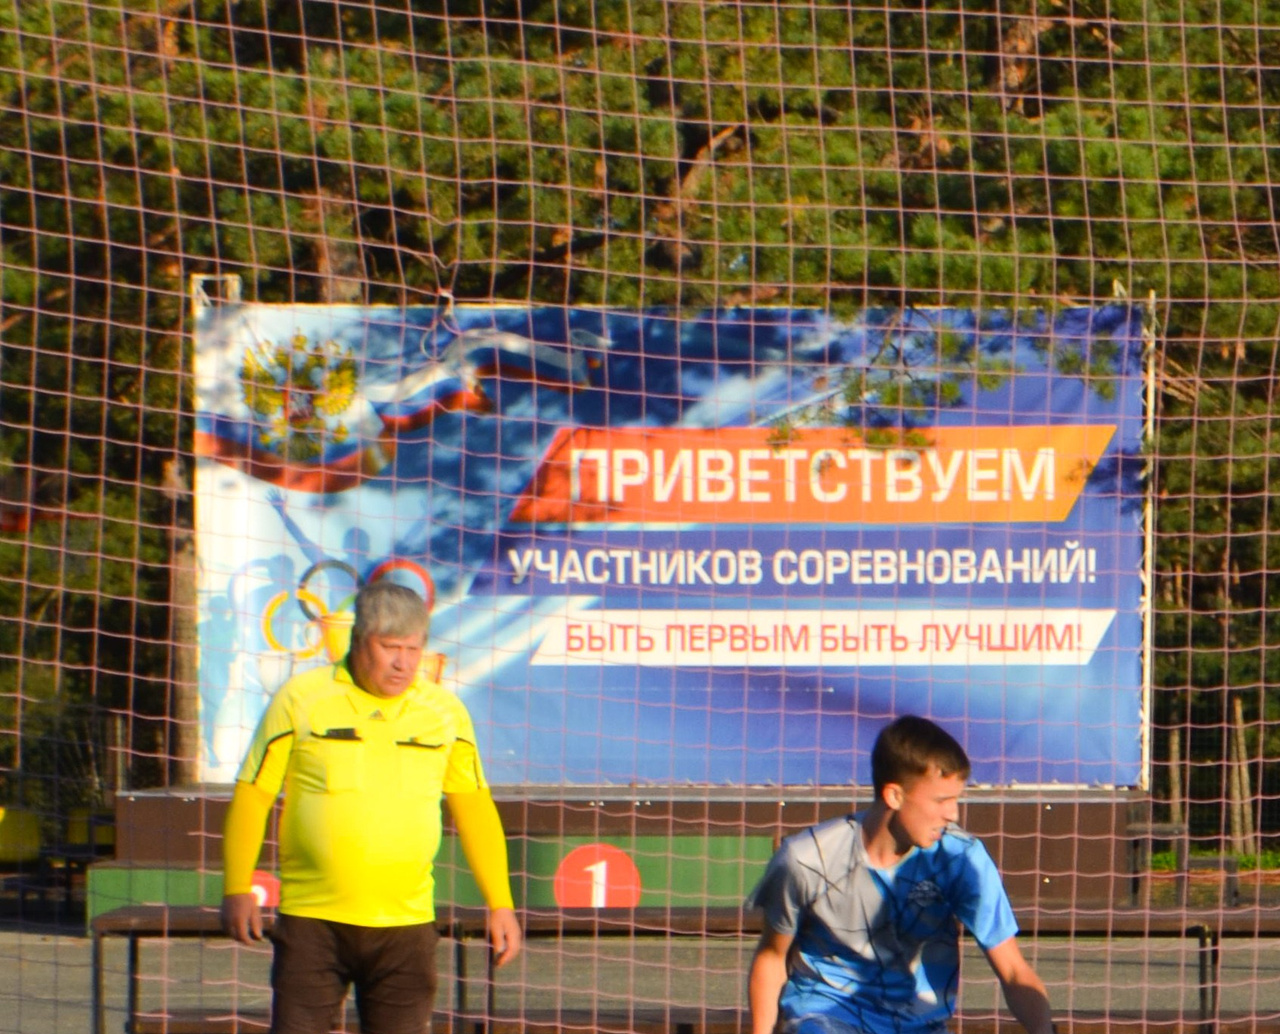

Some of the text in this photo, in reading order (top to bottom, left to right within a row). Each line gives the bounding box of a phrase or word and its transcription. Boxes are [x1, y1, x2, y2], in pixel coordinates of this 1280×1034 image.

[570, 447, 1057, 503] ПРИВЕТСТВУЕМ
[508, 539, 1097, 586] УЧАСТНИКОВ СОРЕВНОВАНИЙ!
[566, 622, 1083, 653] БЫТЬ ПЕРВЫМ БЫТЬ ЛУЧШИМ!
[583, 859, 608, 908] 1
